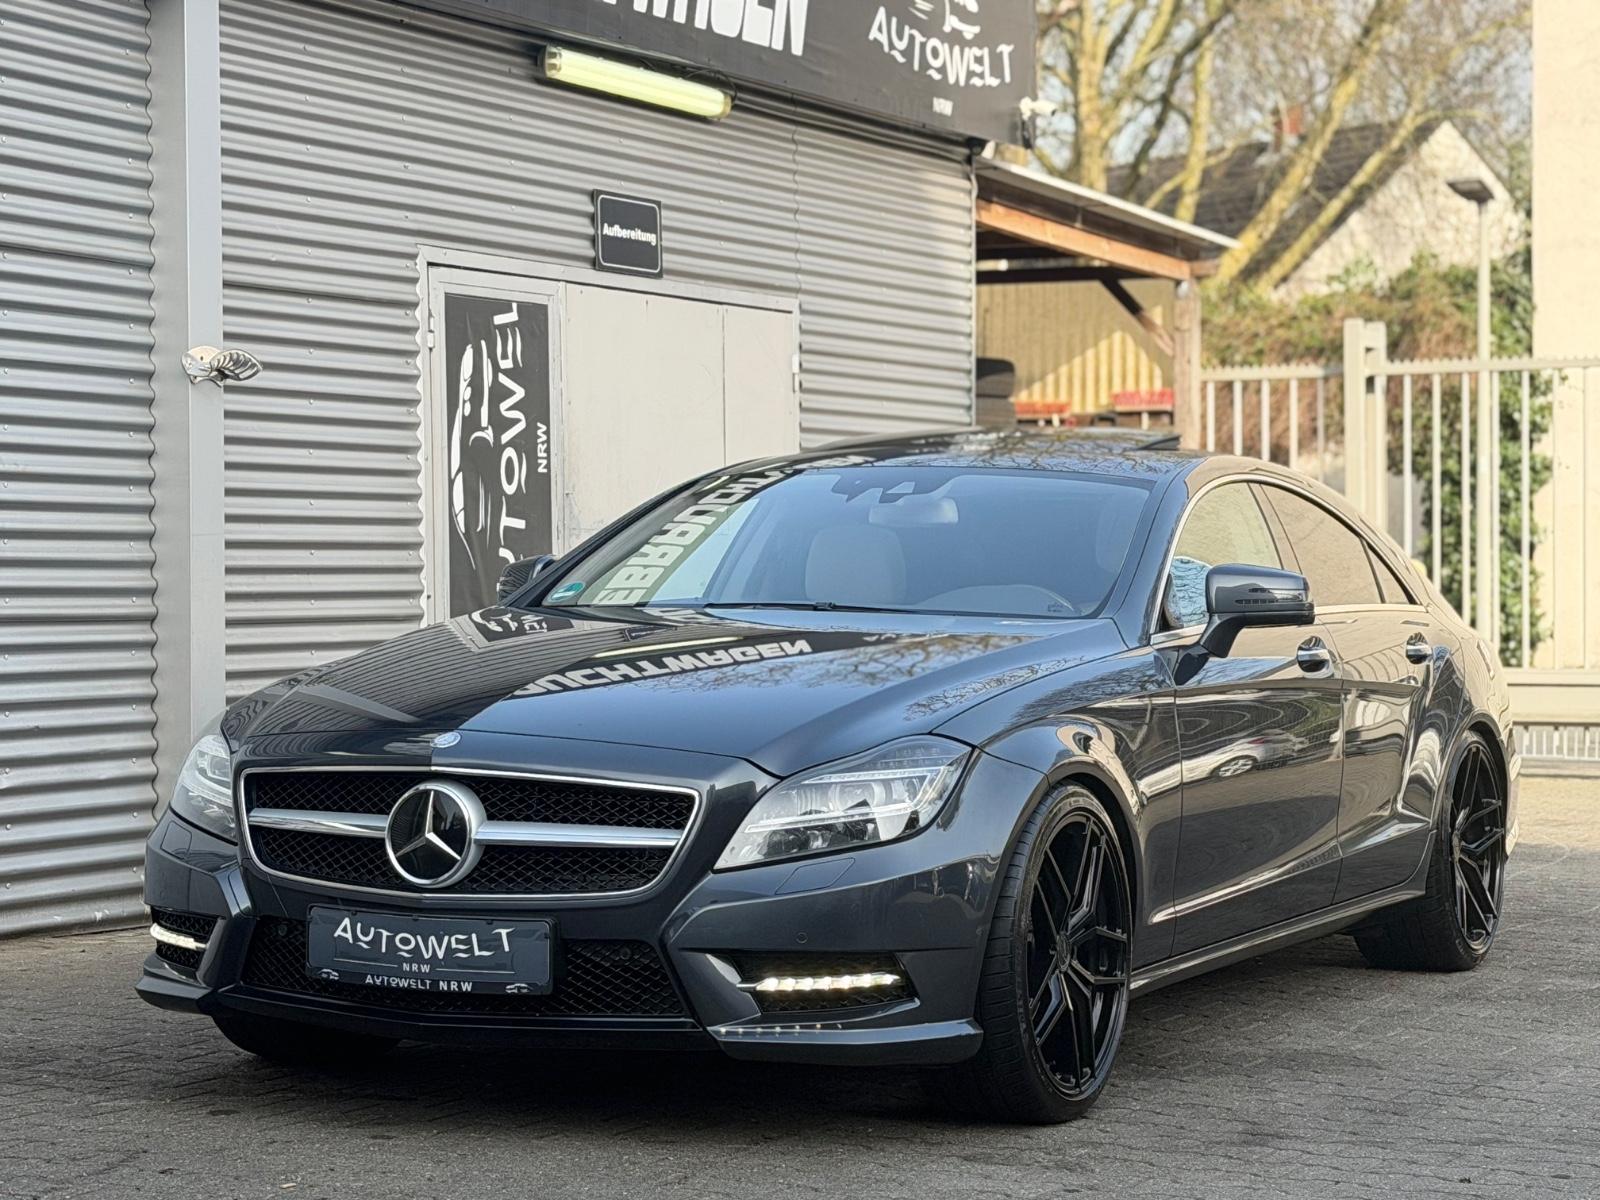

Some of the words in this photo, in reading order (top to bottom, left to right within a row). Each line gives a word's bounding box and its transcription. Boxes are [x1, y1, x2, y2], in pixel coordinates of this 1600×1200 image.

[868, 6, 1015, 87] AUTOWELT
[603, 222, 657, 247] Aufbereitung
[537, 421, 548, 473] NRW
[333, 917, 516, 960] AUTOWELT
[365, 974, 431, 991] AUTOWELT
[439, 980, 473, 993] NRW
[402, 962, 431, 974] NRW
